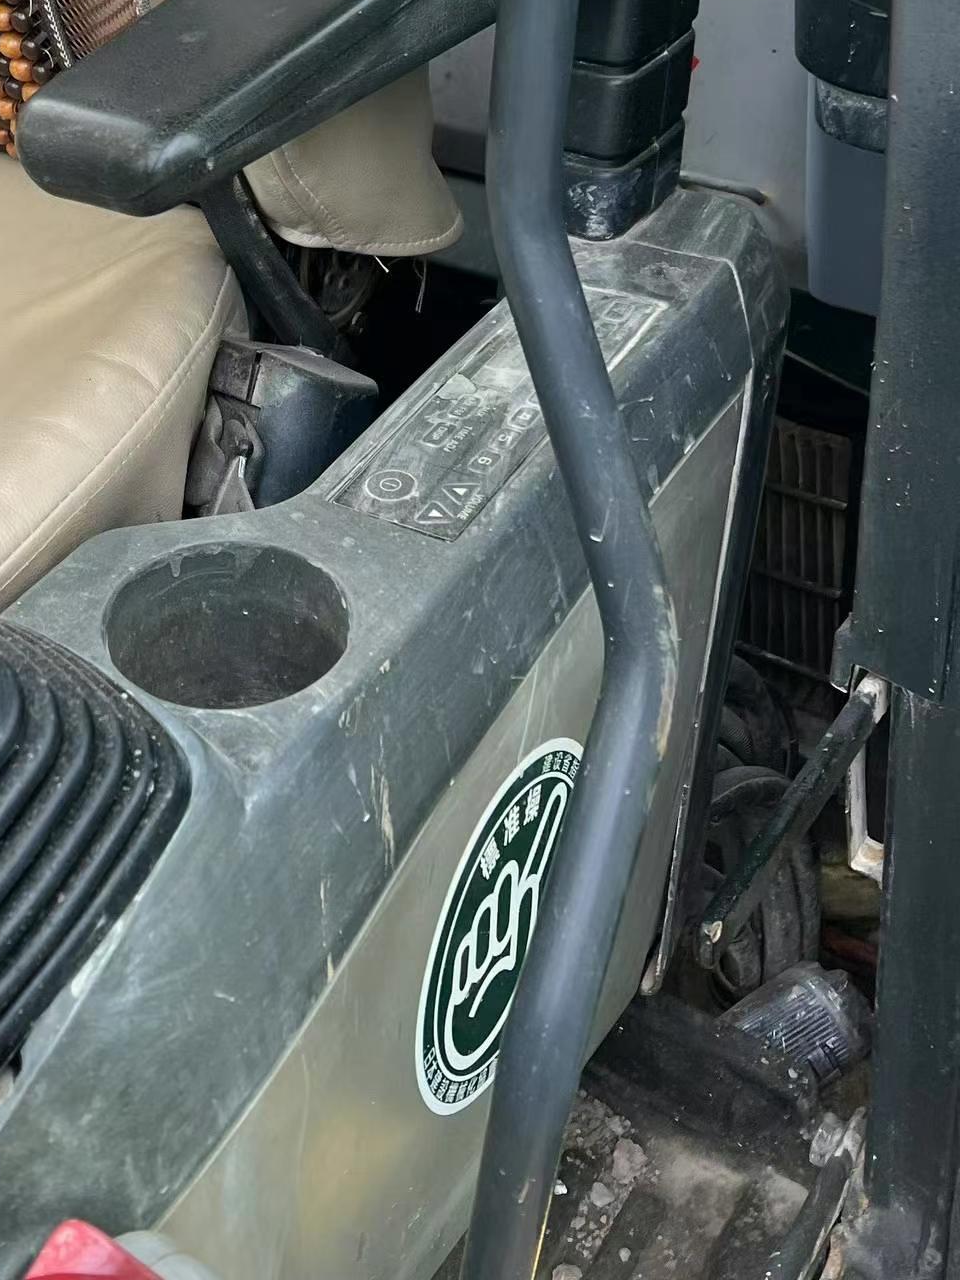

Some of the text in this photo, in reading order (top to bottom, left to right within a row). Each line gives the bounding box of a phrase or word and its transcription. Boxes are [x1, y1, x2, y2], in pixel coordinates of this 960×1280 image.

[517, 411, 532, 422] 4
[498, 433, 513, 444] 5
[478, 456, 493, 465] 6
[457, 494, 485, 520] VOLUME
